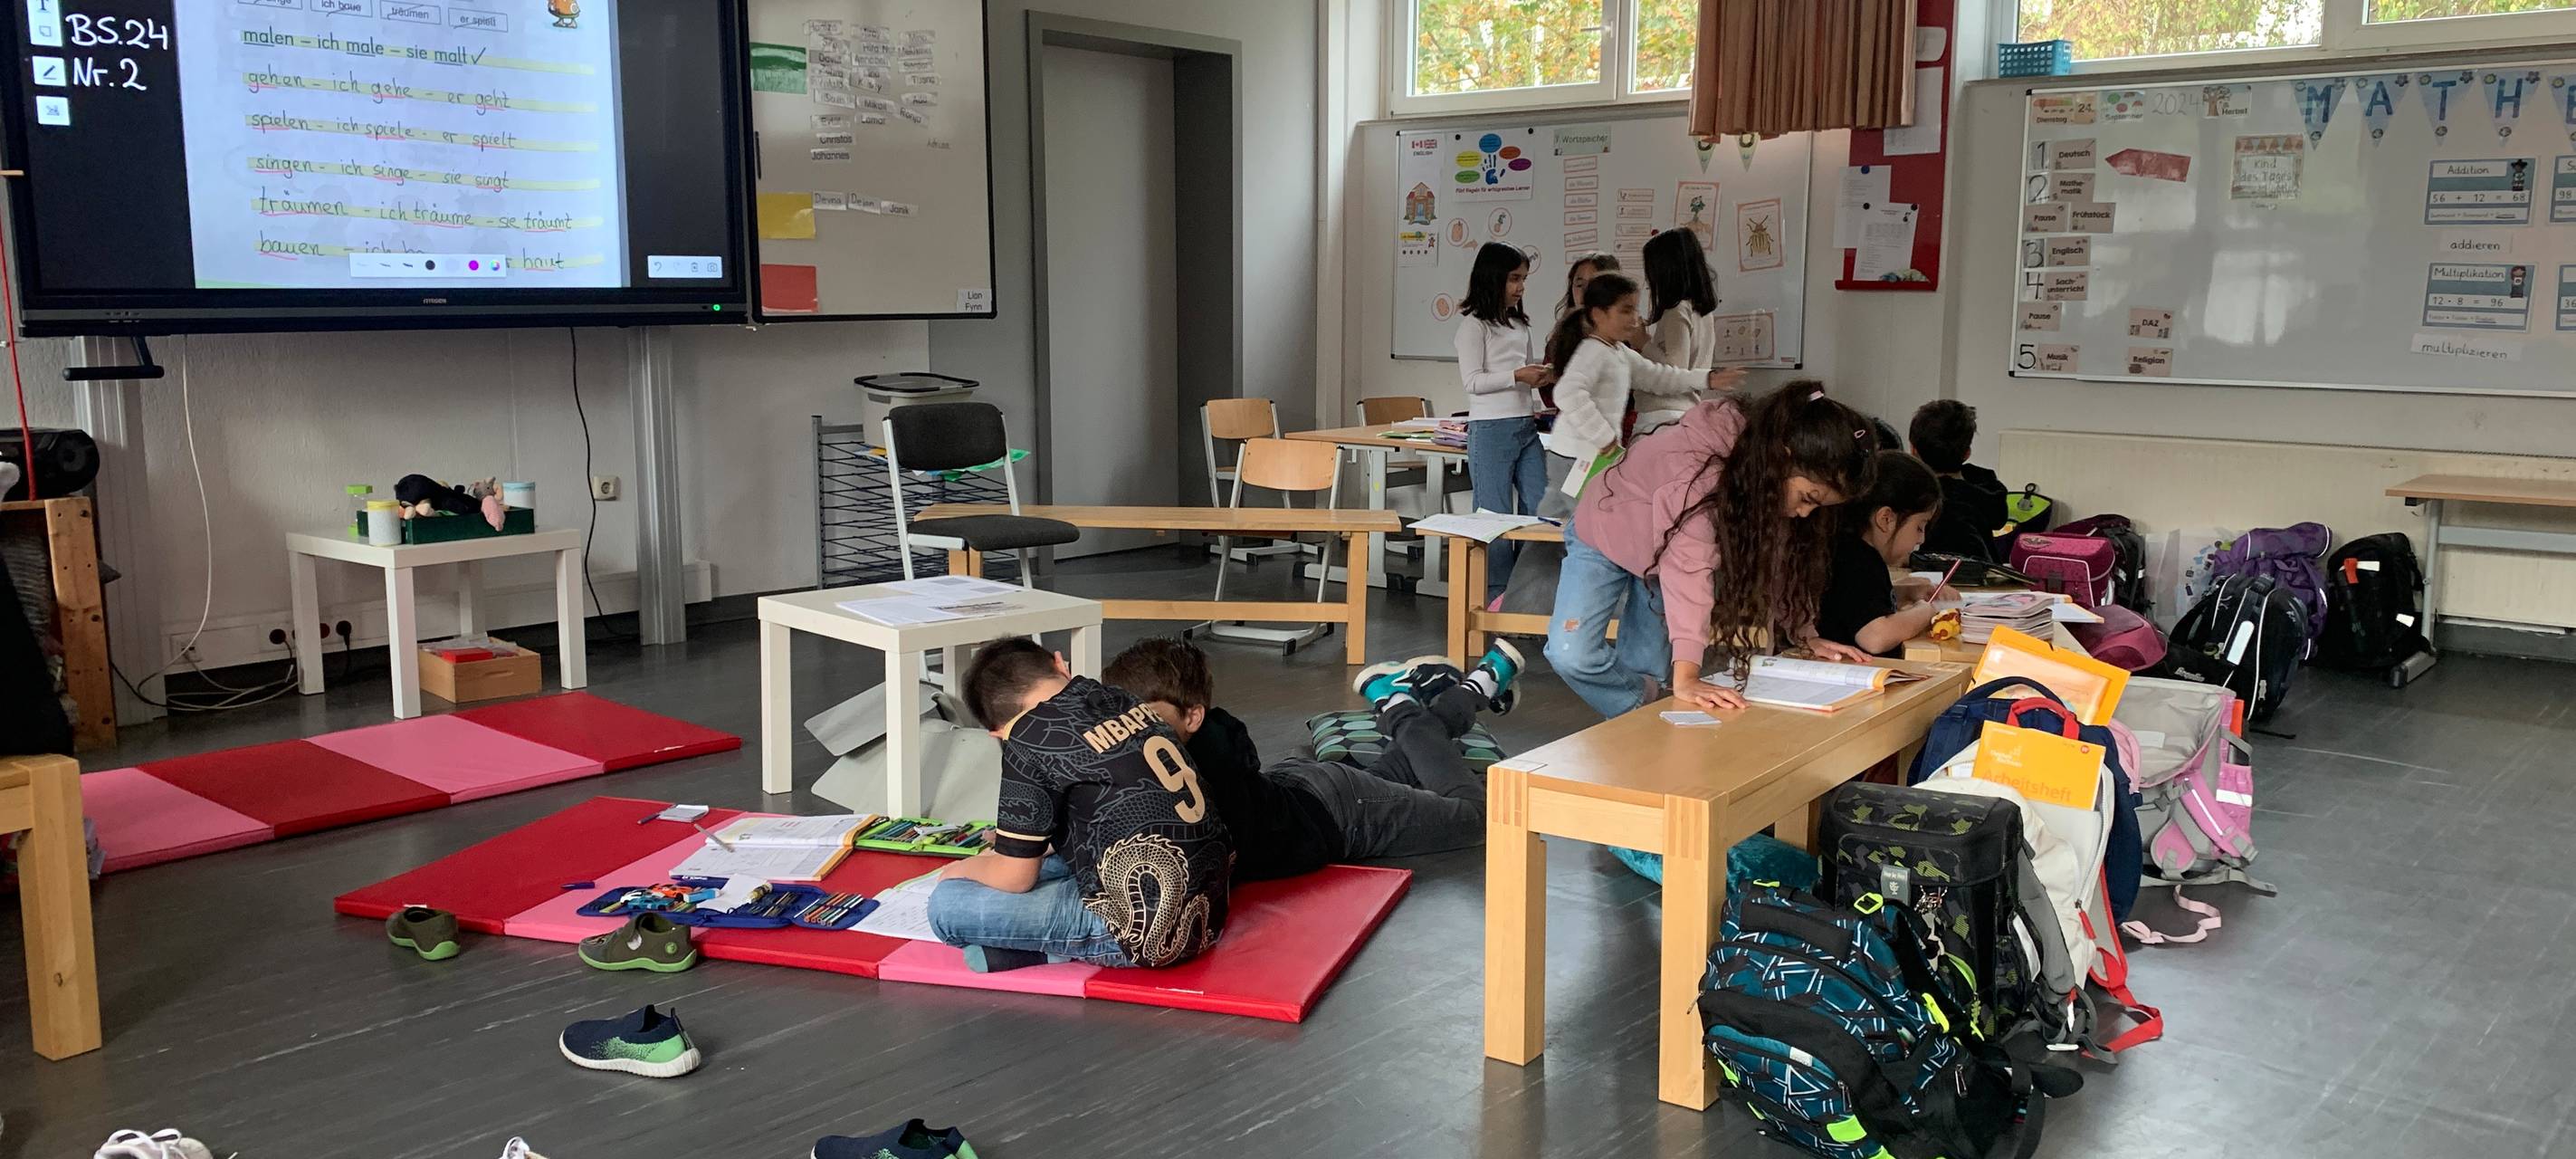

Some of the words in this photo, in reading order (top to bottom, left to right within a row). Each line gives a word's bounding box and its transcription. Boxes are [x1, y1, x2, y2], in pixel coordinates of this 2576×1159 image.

[65, 14, 167, 51] BS.24
[243, 25, 294, 46] malen
[318, 32, 339, 50] ich
[346, 36, 384, 56] male
[406, 45, 427, 60] sie
[434, 46, 467, 64] malt
[73, 57, 115, 87] Nr.
[119, 58, 147, 91] 2
[248, 63, 305, 93] gehen
[332, 71, 360, 92] ich
[371, 77, 413, 104] gehe
[447, 93, 464, 104] er
[475, 90, 510, 116] geht
[2221, 108, 2248, 116] Herbst
[2037, 116, 2068, 125] Dienstag
[252, 110, 311, 134] spielen
[337, 117, 358, 132] ich
[366, 120, 415, 141] spiele
[442, 131, 458, 144] er
[472, 131, 516, 152] spielt
[2058, 149, 2091, 159] Deutsch
[2254, 158, 2277, 169] Kind
[256, 153, 314, 179] singen
[341, 158, 364, 176] ich
[372, 160, 413, 187] singe
[443, 169, 463, 185] sie
[475, 171, 510, 193] singt
[2447, 165, 2489, 175] Addition
[2432, 194, 2446, 203] 56
[2473, 193, 2485, 203] 12
[2512, 193, 2525, 202] 68
[259, 186, 348, 216] träumen
[380, 201, 407, 221] ich
[414, 201, 474, 225] träume
[524, 210, 573, 230] träumt
[2033, 214, 2057, 223] Pause
[2072, 210, 2112, 219] Frühstück
[260, 230, 326, 256] bauen
[2449, 239, 2501, 251] addieren
[2052, 246, 2084, 256] Englisch
[2434, 267, 2505, 282] Multiplikation
[965, 302, 983, 312] Fynn
[2432, 296, 2444, 306] 12
[2457, 297, 2464, 306] 8
[2490, 298, 2504, 307] 96
[2028, 312, 2052, 321] Pause
[2421, 341, 2508, 359] multiplizieren
[2046, 352, 2069, 361] Musik
[2132, 355, 2166, 366] Religion
[1142, 735, 1206, 824] 9
[1981, 768, 2072, 802] Arbeitsheft
